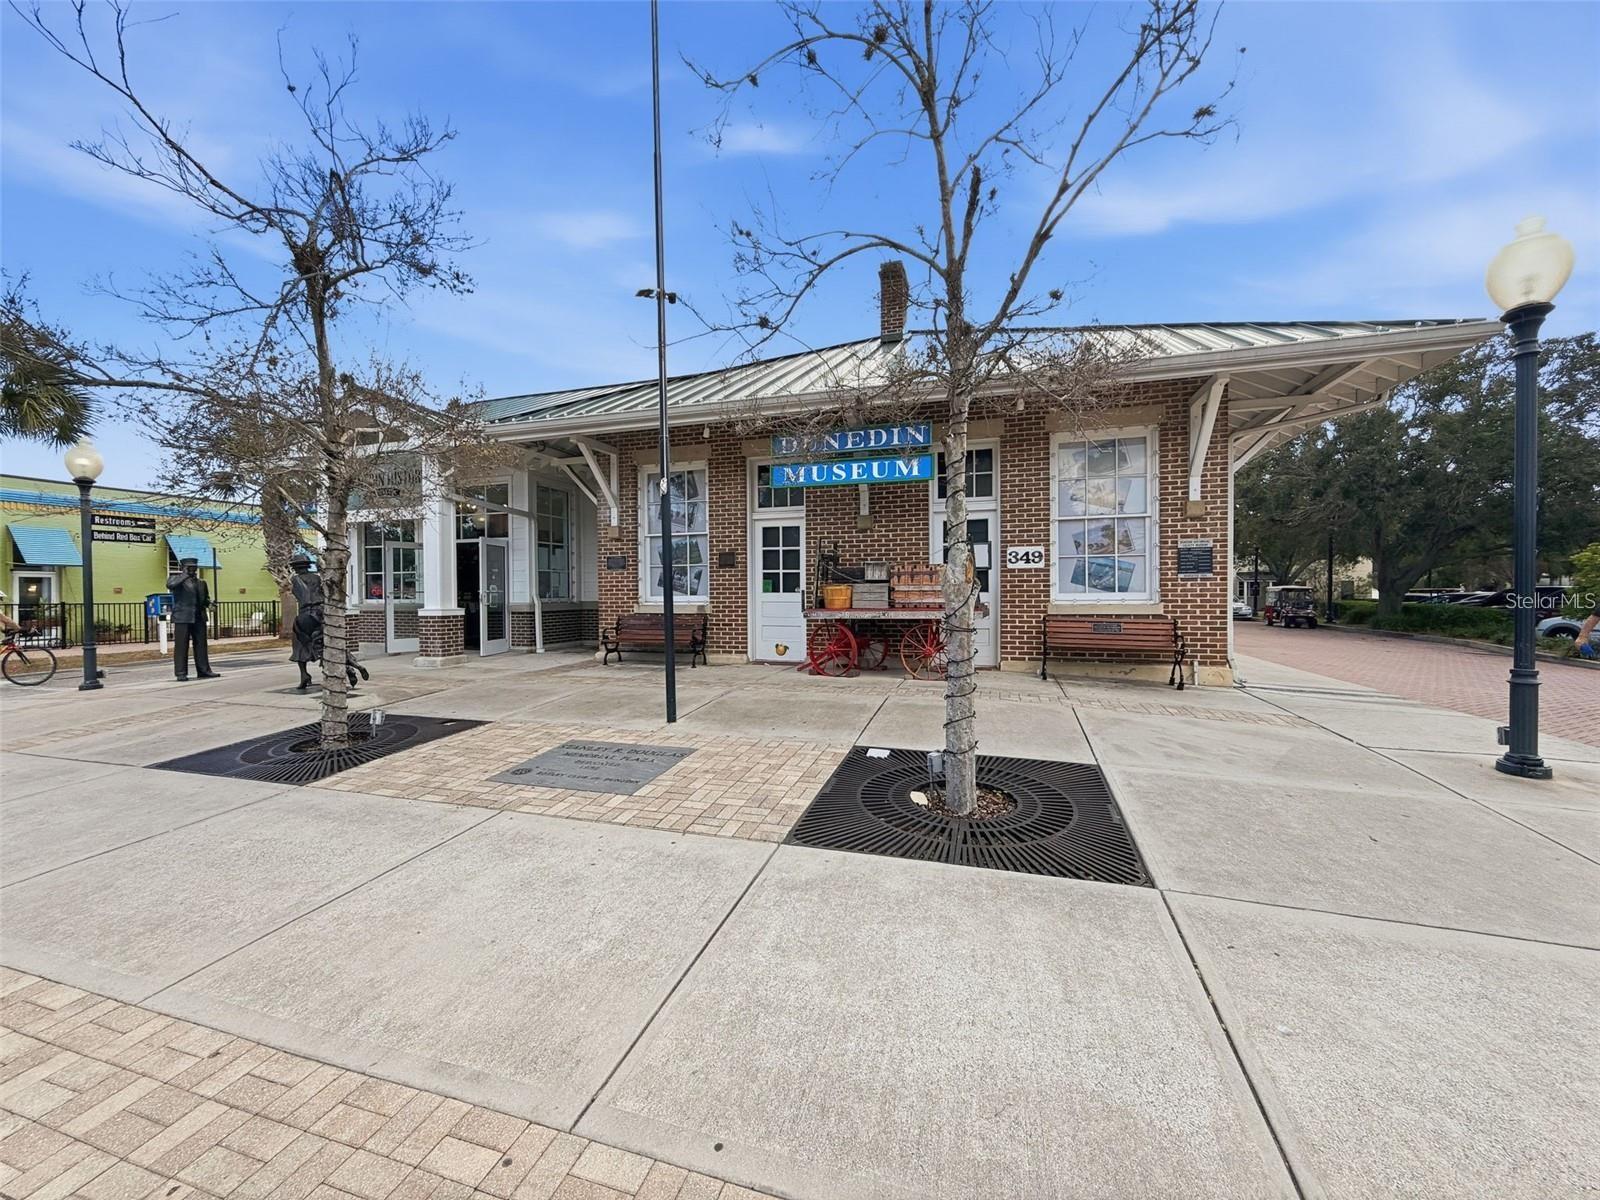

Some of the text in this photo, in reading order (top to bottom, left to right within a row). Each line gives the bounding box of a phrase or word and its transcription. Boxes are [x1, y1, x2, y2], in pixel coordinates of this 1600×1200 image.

[782, 457, 921, 485] MUSEUM
[94, 516, 136, 526] Restrooms
[93, 532, 152, 542] Behind Red Box Car
[1008, 550, 1044, 565] 349
